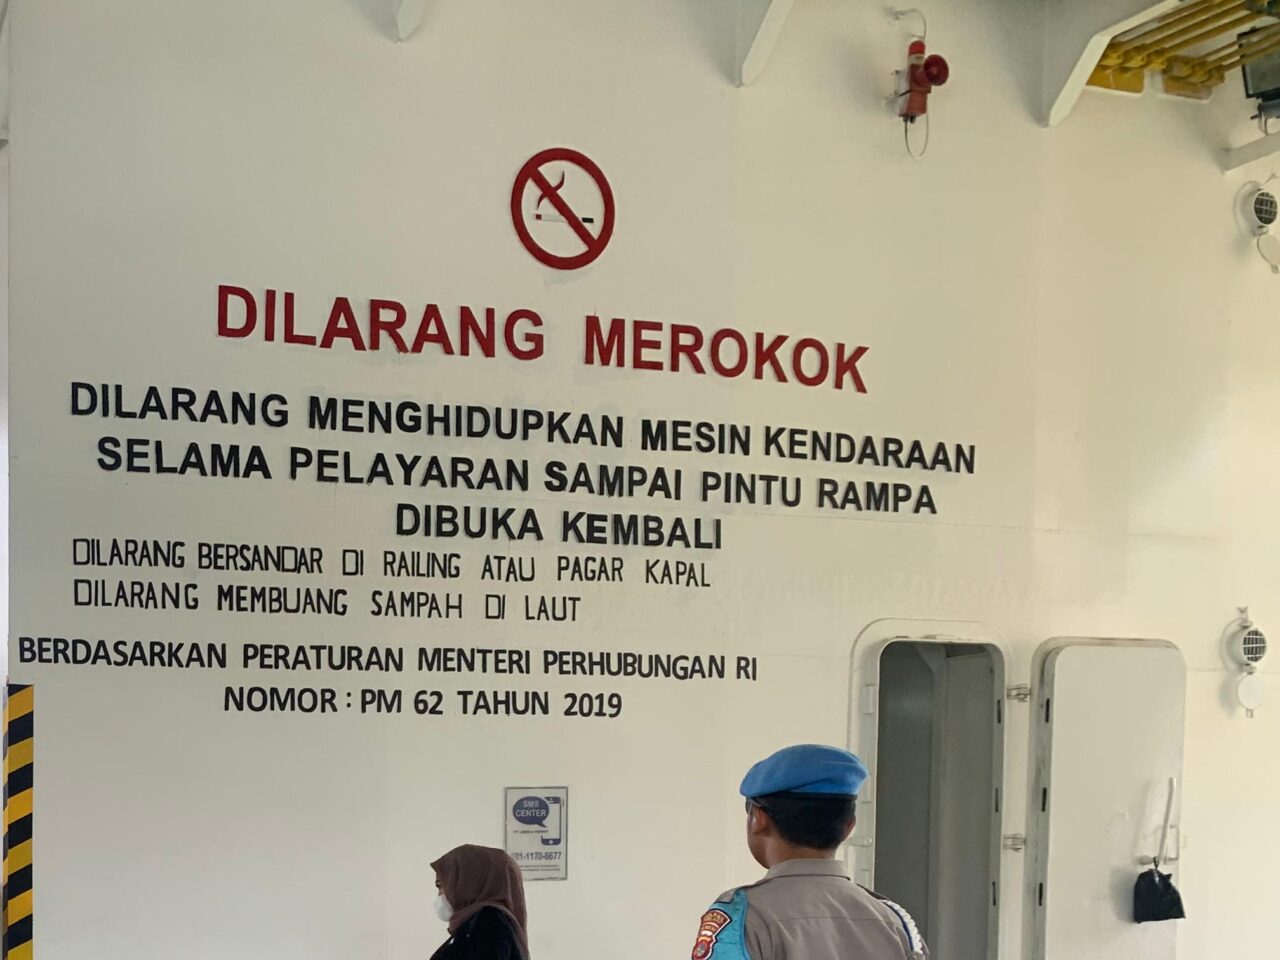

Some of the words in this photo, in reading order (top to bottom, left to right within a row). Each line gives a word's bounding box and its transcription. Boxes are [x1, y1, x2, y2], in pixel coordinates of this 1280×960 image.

[217, 284, 544, 361] DILARANG
[583, 315, 870, 394] MEROKOK
[70, 381, 289, 428] DILARANG
[307, 395, 624, 449] MENGHIDUPKAN
[640, 418, 751, 457] MESIN
[764, 425, 976, 475] KENDARAAN
[96, 435, 273, 480] SELAMA
[288, 446, 529, 493] PELAYARAN
[543, 460, 682, 501] SAMPAI
[701, 470, 802, 508] PINTU
[817, 477, 938, 515] RAMPA
[395, 502, 544, 542] DIBUKA
[561, 510, 722, 550] KEMBALI
[72, 537, 186, 569] DILARANG
[197, 541, 324, 575] BERSANDAR
[341, 548, 365, 577] DI
[383, 550, 462, 579] RAILING
[480, 554, 536, 583] ATAU
[557, 555, 624, 583] PAGAR
[645, 558, 711, 588] KAPAL
[73, 578, 199, 611] DILARANG
[216, 584, 348, 617] MEMBUANG
[370, 589, 463, 619] SAMPAH
[484, 593, 506, 620] DI
[524, 594, 582, 622] LAUT
[18, 636, 227, 669] BERDASARKAN
[242, 643, 404, 673] PERATURAN
[417, 647, 531, 675] MENTERI
[542, 649, 726, 681] PERHUBUNGAN
[736, 655, 757, 682] RI
[223, 685, 338, 714] NOMOR
[360, 688, 403, 714] PM
[413, 689, 444, 716] 62
[456, 690, 550, 717] TAHUN
[563, 692, 623, 719] 2019
[515, 809, 547, 818] CENTER
[522, 800, 540, 808] SMS
